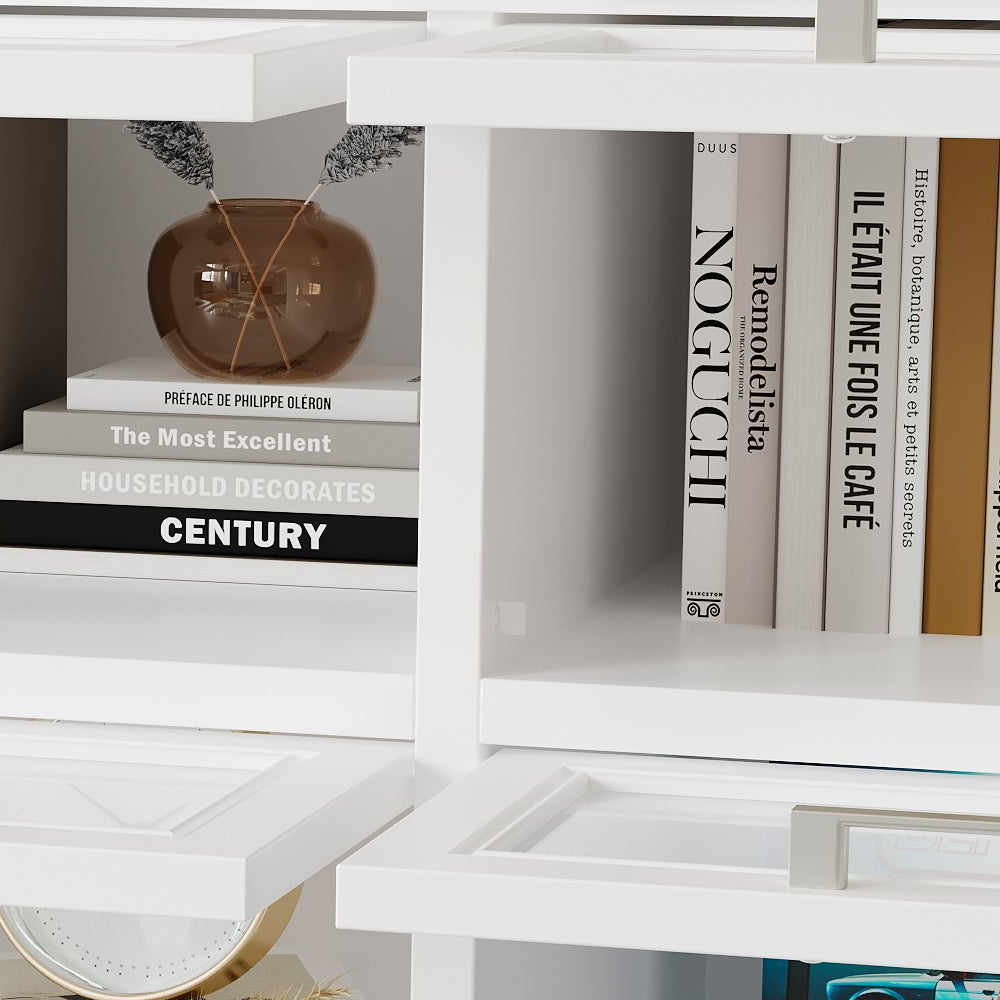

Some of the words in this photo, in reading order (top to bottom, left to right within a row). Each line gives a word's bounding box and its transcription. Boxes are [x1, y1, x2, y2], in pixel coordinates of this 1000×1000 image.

[697, 142, 738, 155] DUUS
[853, 191, 885, 214] IL
[910, 168, 929, 248] Histoire,
[850, 222, 892, 295] ÉTAIT
[848, 302, 882, 354] UNE
[907, 255, 926, 350] botanique,
[688, 225, 735, 510] NOGUCHI
[747, 263, 778, 454] Remodelista
[906, 356, 920, 394] arts
[164, 390, 213, 407] PRÉFACE
[217, 393, 232, 407] DE
[235, 394, 284, 409] PHILIPPE
[288, 393, 332, 411] OLÉRON
[846, 362, 879, 419] FOIS
[906, 400, 919, 418] et
[110, 425, 151, 447] The
[158, 428, 216, 450] Most
[223, 430, 333, 454] Excellent
[845, 427, 877, 457] LE
[903, 424, 919, 476] petits
[81, 470, 228, 499] HOUSEHOLD
[235, 478, 377, 505] DECORATES
[842, 464, 881, 530] CAFÉ
[160, 516, 329, 551] CENTURY
[901, 482, 916, 549] secrets
